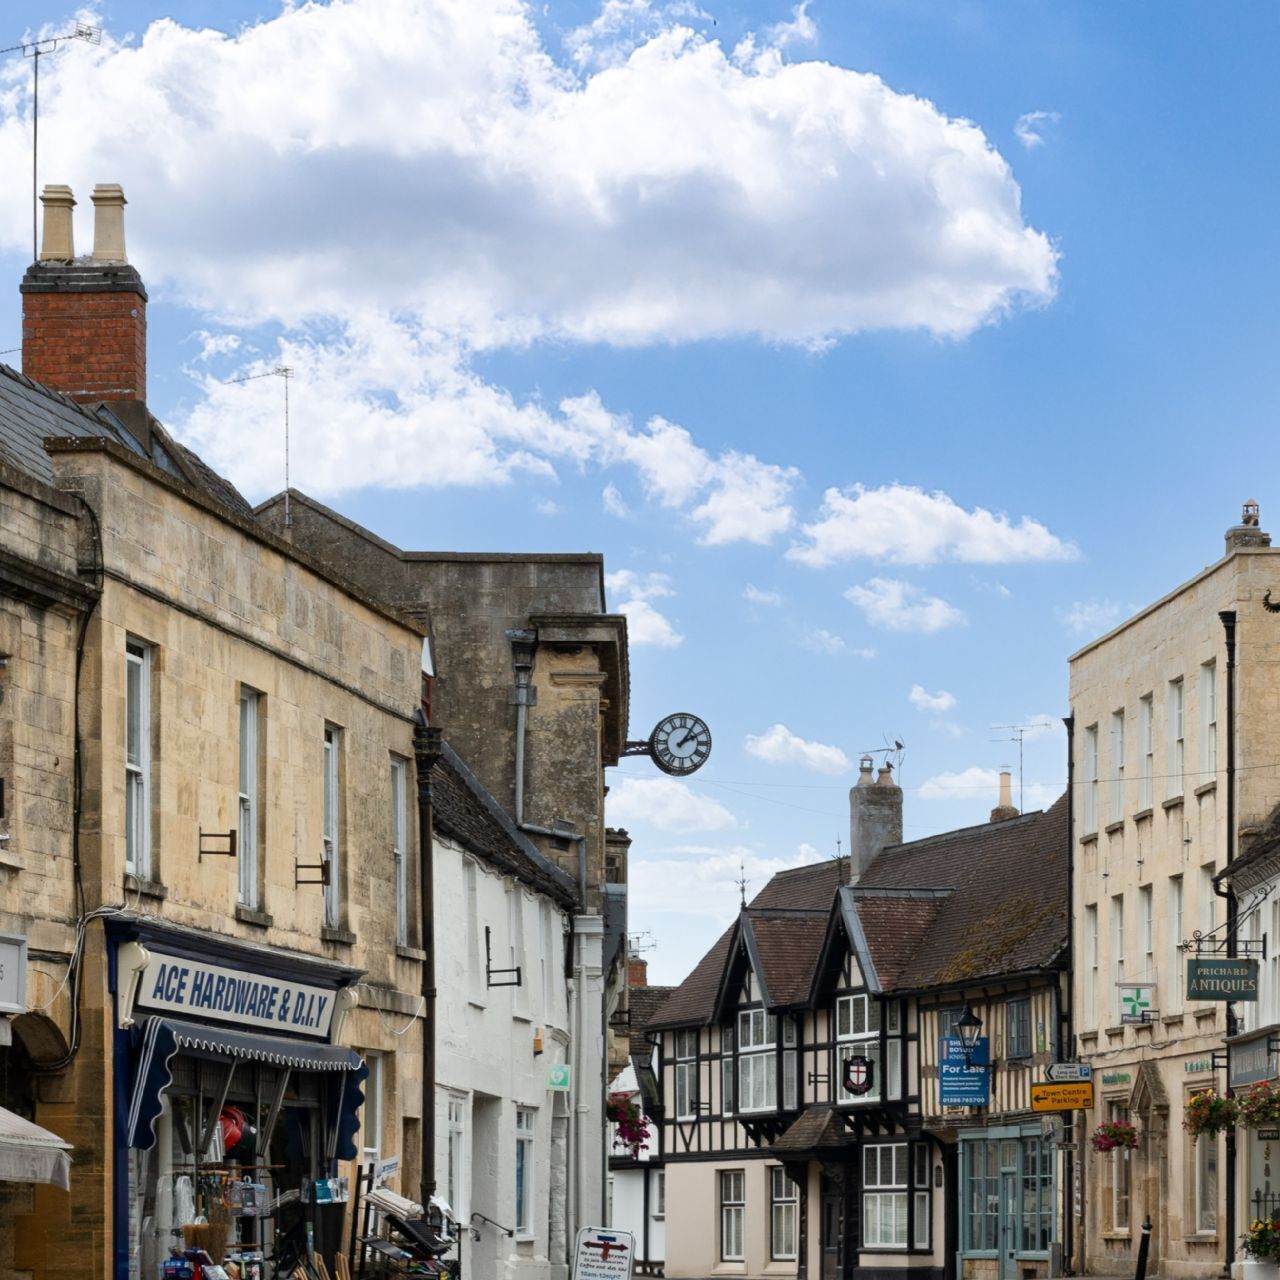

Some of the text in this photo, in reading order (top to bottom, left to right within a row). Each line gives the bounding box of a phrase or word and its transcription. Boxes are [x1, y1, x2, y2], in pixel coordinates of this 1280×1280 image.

[1197, 967, 1249, 976] PRICHARD
[1190, 979, 1256, 993] ANTIQUES
[152, 963, 190, 1004] ACE
[189, 970, 279, 1020] HARDWARE
[278, 989, 291, 1022] &
[942, 1064, 961, 1074] For
[1062, 1088, 1087, 1096] Centre
